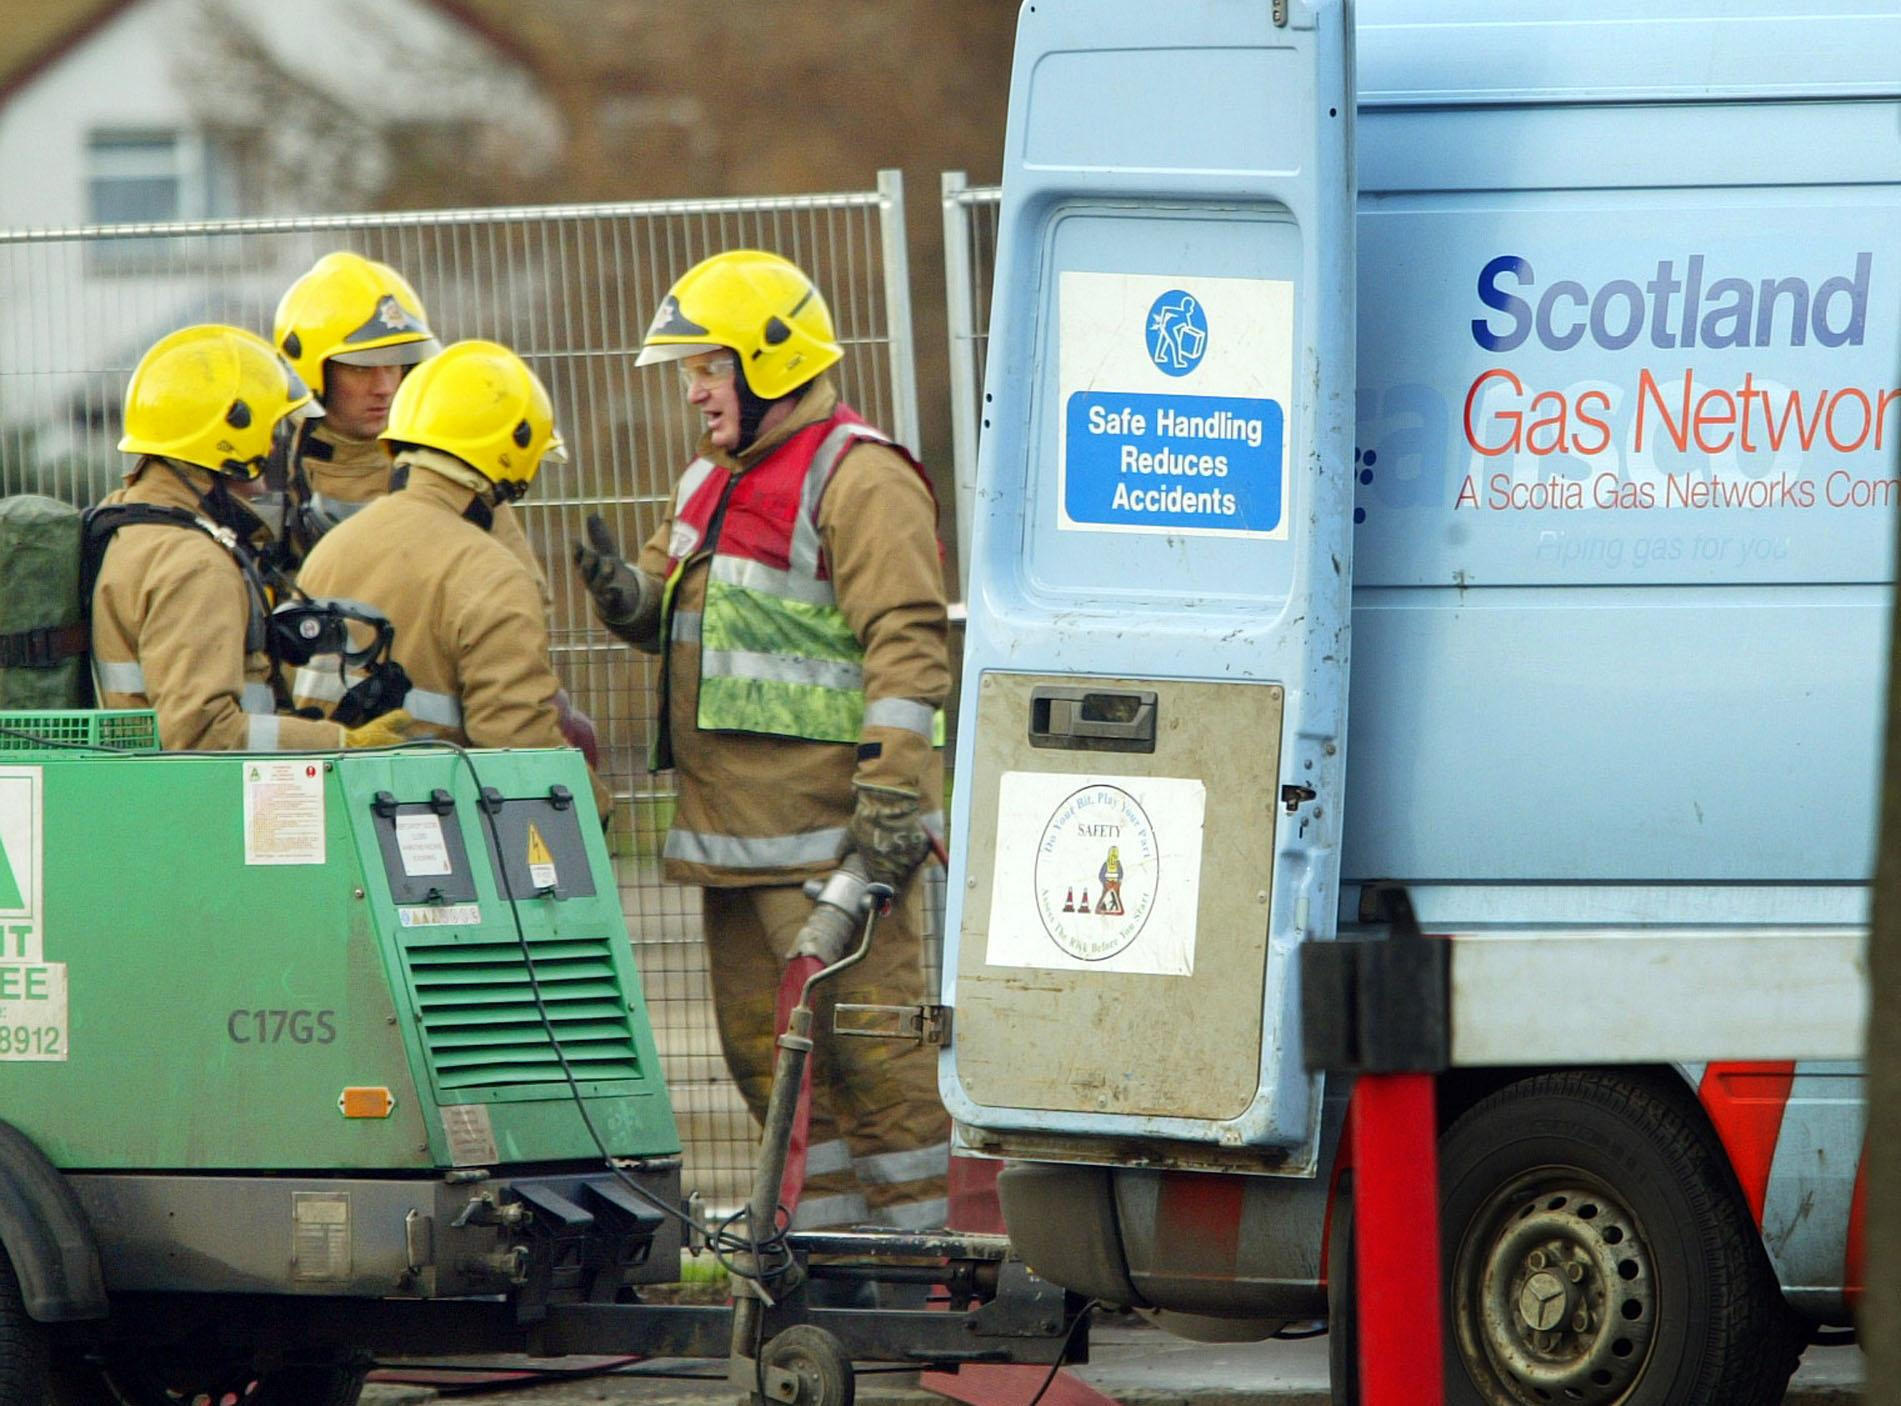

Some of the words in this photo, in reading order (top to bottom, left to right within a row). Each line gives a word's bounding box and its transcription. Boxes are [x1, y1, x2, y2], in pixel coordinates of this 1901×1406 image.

[1471, 252, 1873, 352] Scotland
[1088, 405, 1147, 436] Safe
[1156, 408, 1263, 448] Handling
[1463, 368, 1611, 456] Gas
[1634, 367, 1901, 454] Networ
[1120, 445, 1229, 477] Reduces
[1111, 482, 1236, 515] Accidents
[1454, 475, 1479, 511] A
[1488, 473, 1583, 510] Scotia
[1593, 472, 1655, 509] Gas
[1666, 471, 1815, 508] Networks
[1535, 529, 1625, 569] Piping
[1632, 536, 1684, 568] gas
[1692, 531, 1732, 561] for
[1739, 536, 1790, 567] you
[1097, 791, 1117, 810] Play
[1078, 823, 1121, 838] SAFETY
[0, 1025, 60, 1054] 8912
[226, 1008, 337, 1045] C17GS
